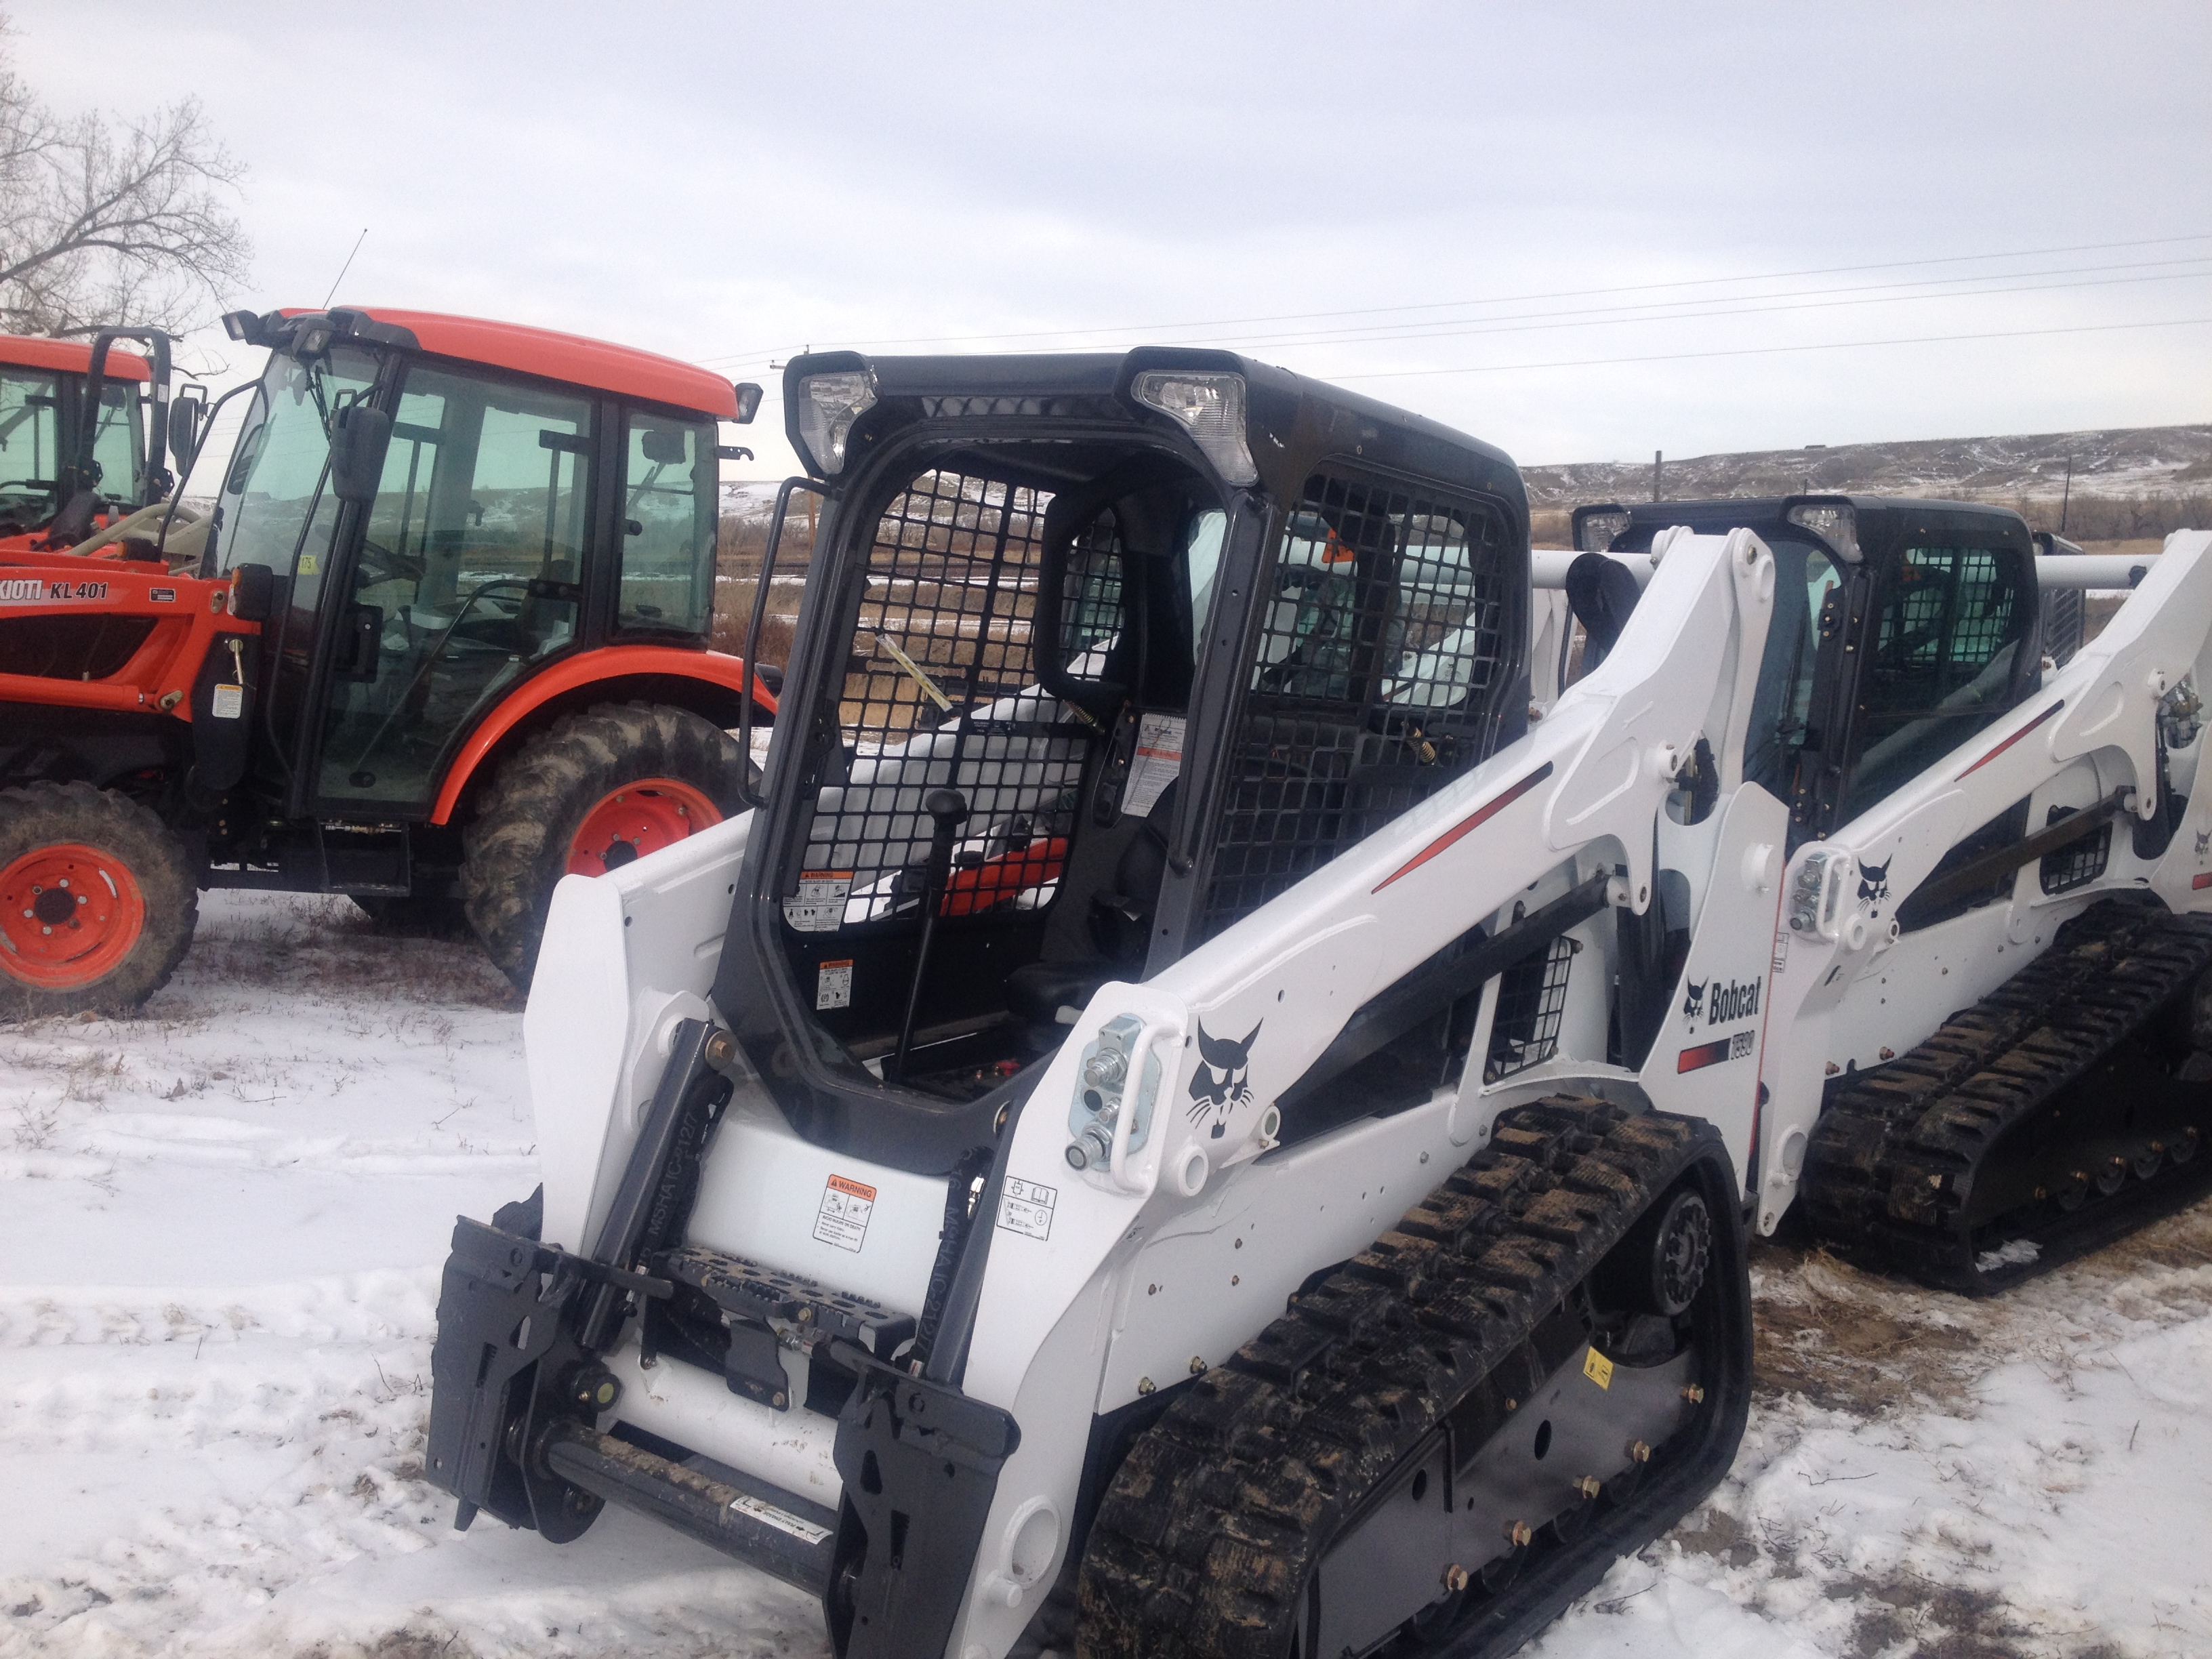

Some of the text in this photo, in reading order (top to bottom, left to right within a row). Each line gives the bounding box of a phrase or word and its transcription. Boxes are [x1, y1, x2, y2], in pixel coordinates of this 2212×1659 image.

[1708, 976, 1762, 1025] Bobcat
[647, 1183, 676, 1235] MSHA
[839, 1181, 873, 1197] WARNING
